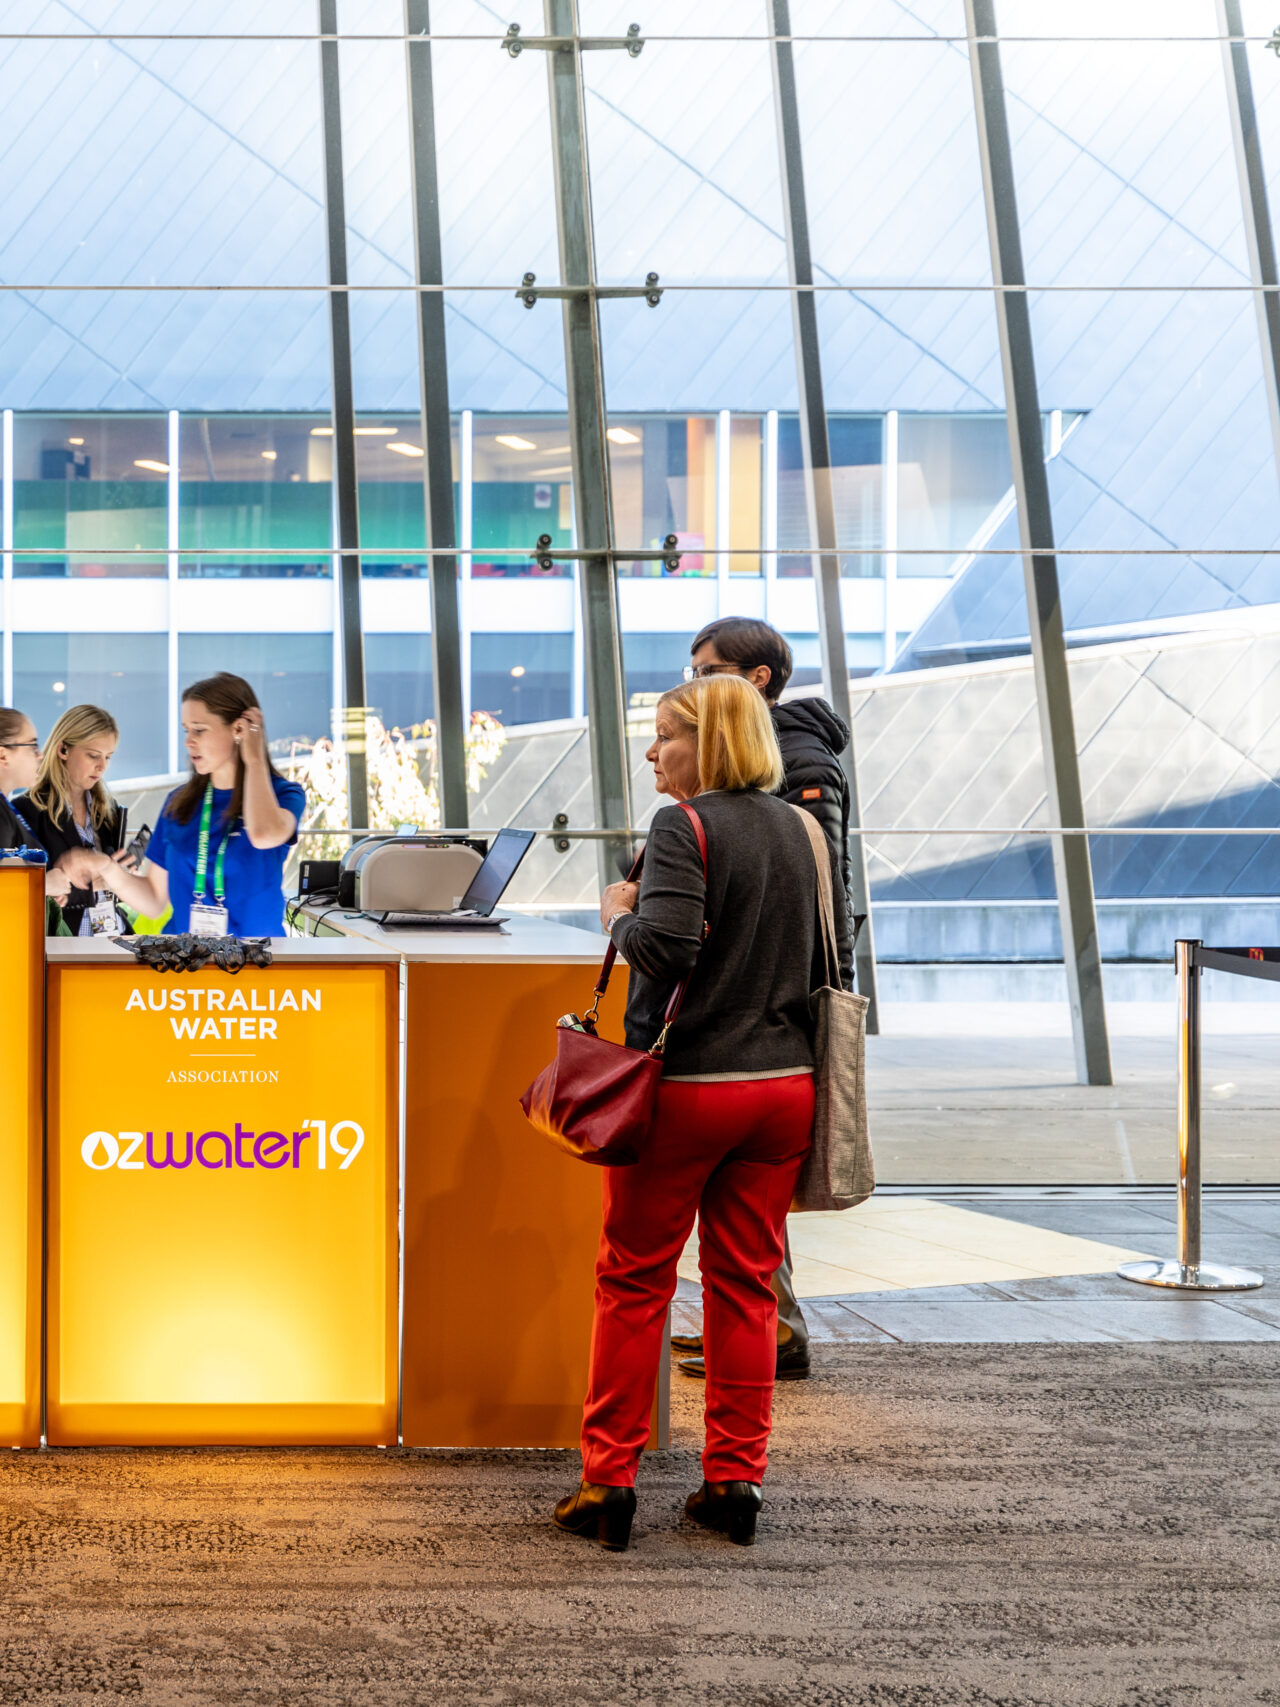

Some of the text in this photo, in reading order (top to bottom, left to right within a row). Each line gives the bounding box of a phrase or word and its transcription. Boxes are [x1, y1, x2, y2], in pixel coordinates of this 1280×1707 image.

[196, 830, 210, 875] VOLUNTEER
[125, 988, 322, 1011] AUSTRALIAN
[169, 1017, 278, 1040] WATER
[166, 1070, 279, 1083] ASSOCIATION
